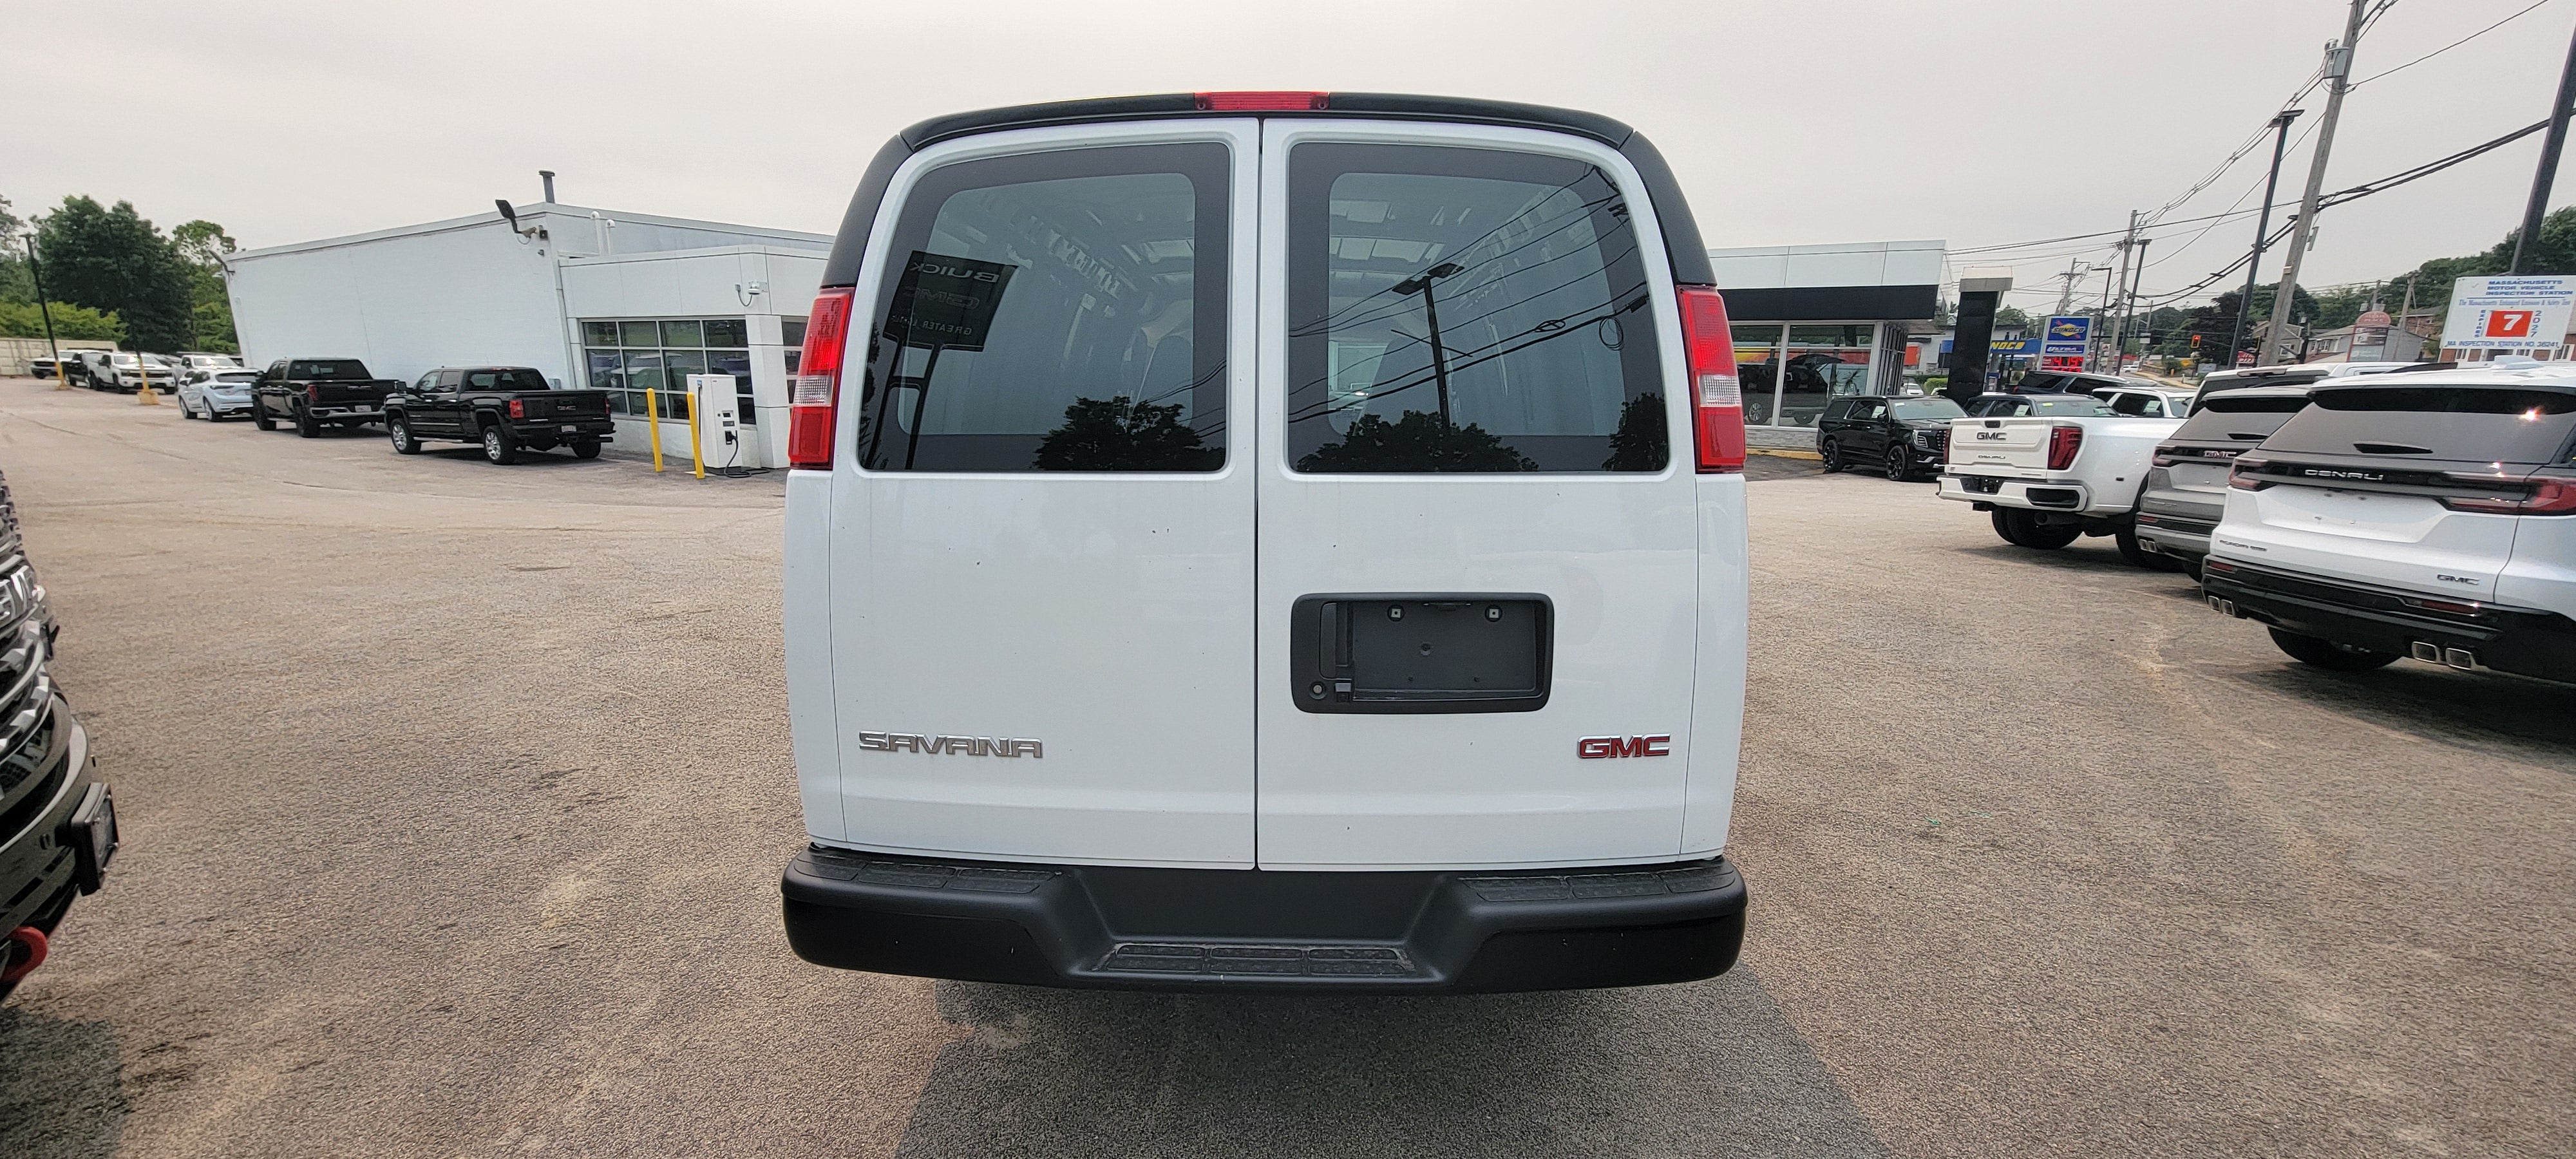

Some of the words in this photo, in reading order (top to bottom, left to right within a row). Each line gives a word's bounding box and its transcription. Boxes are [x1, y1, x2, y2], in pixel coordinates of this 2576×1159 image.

[2503, 314, 2523, 330] 7
[2304, 469, 2383, 481] DENALI
[2437, 574, 2479, 585] GMC
[859, 730, 1043, 758] SAVANA
[1577, 733, 1670, 759] GMC
